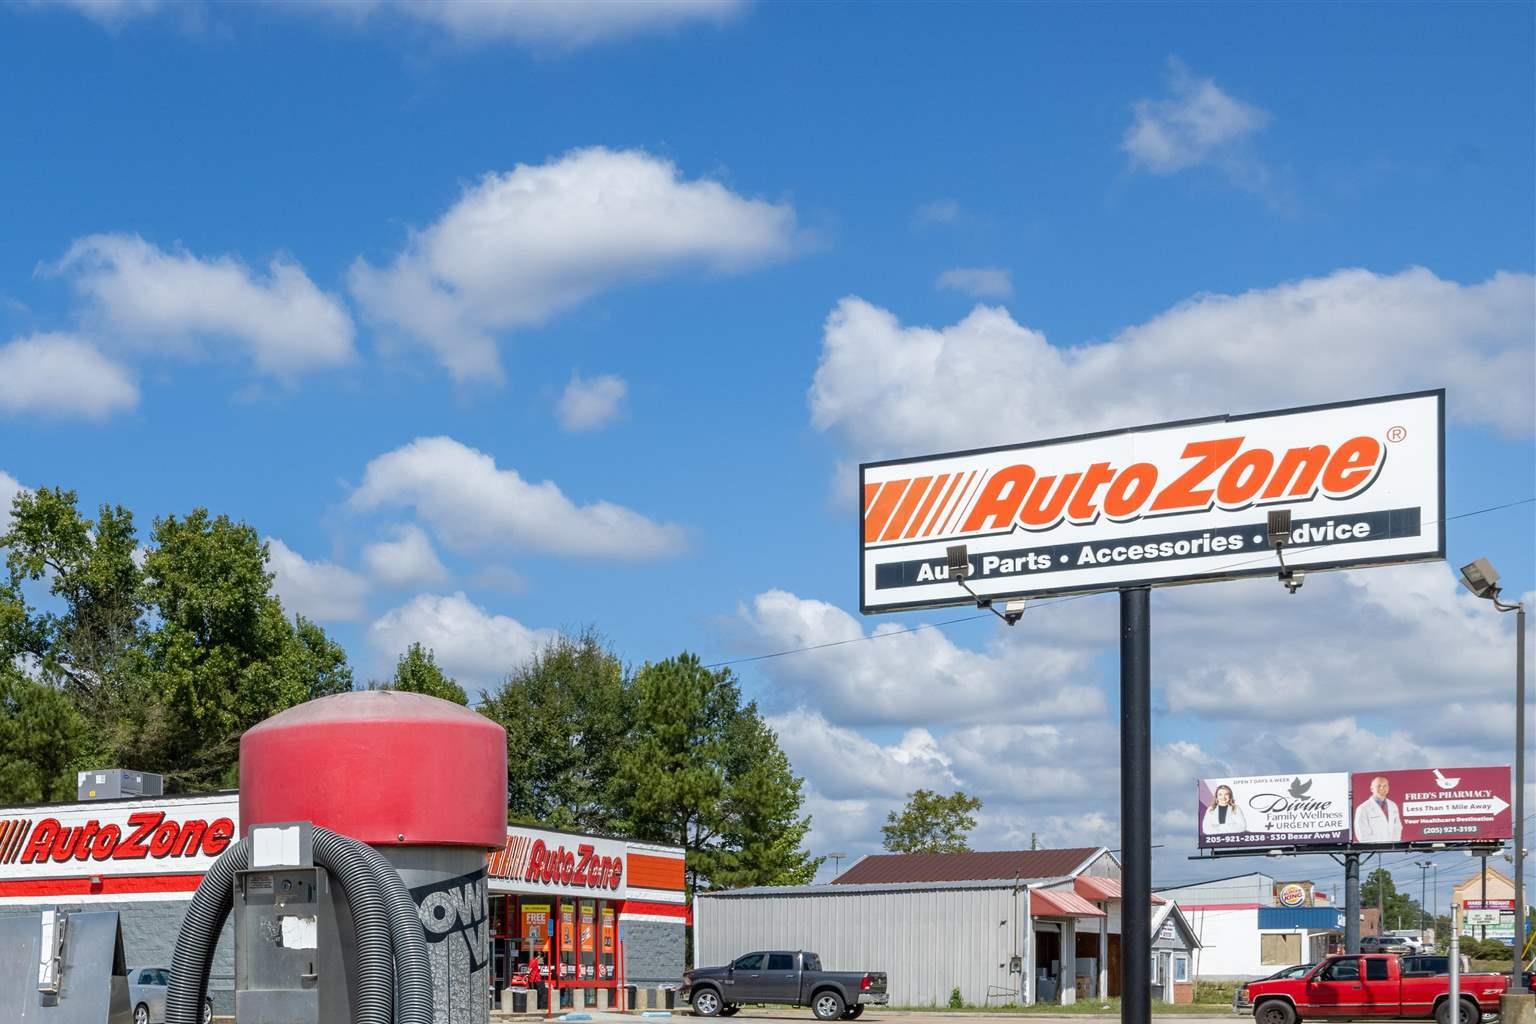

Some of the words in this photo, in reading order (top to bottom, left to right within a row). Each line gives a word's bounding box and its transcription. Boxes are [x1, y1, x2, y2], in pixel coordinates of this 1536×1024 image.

[961, 434, 1384, 534] AutoZone
[916, 562, 975, 582] Au
[982, 552, 1052, 575] Parts
[1076, 531, 1244, 567] Accessories
[1288, 520, 1371, 544] dvice
[1405, 792, 1436, 800] FRED'S
[1438, 790, 1492, 799] PHARMACY
[1249, 793, 1332, 814] Divine
[1266, 813, 1299, 822] Family
[1300, 810, 1344, 820] Wellness
[1276, 820, 1316, 830] URGENT
[1318, 820, 1343, 828] CARE
[1444, 826, 1477, 834] 921-3193
[20, 811, 235, 864] AutoZone
[1206, 834, 1266, 844] 205-921-2838
[524, 838, 623, 890] AutoZone
[1284, 892, 1302, 900] KING
[527, 912, 546, 922] FREE
